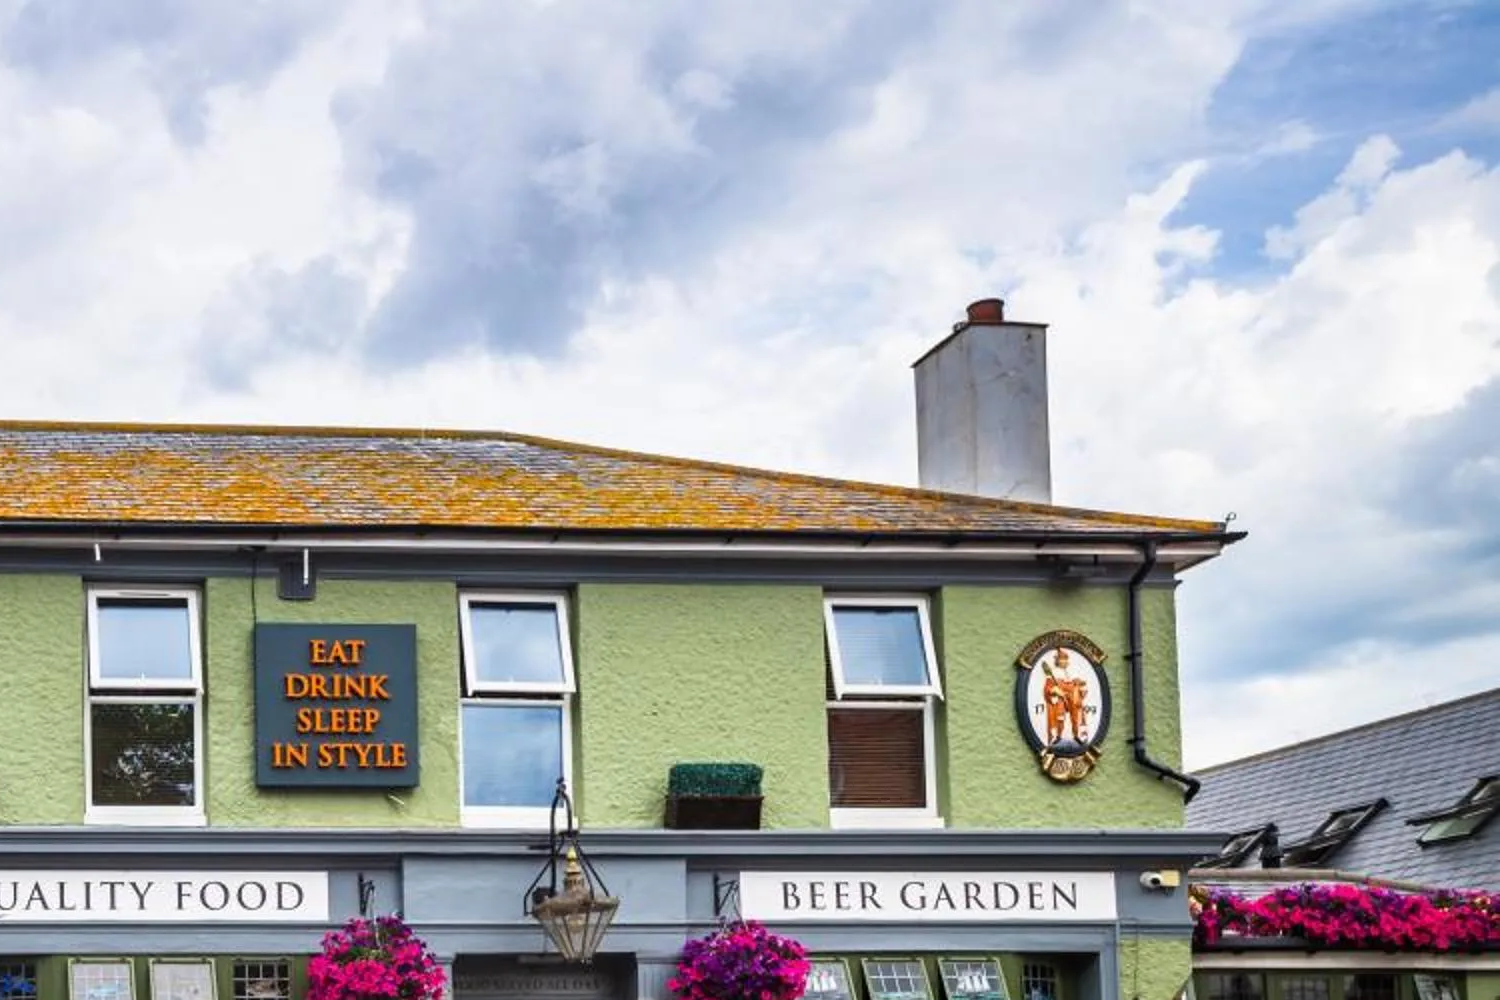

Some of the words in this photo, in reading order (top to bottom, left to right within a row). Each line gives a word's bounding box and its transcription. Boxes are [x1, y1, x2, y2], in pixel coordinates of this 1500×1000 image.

[309, 639, 366, 665] EAT
[284, 673, 391, 700] DRINK
[296, 707, 381, 734] SLEEP
[272, 741, 308, 768] IN
[318, 741, 408, 769] STYLE
[175, 881, 306, 911] FOOD
[781, 880, 884, 911] BEER
[899, 880, 1079, 911] GARDEN
